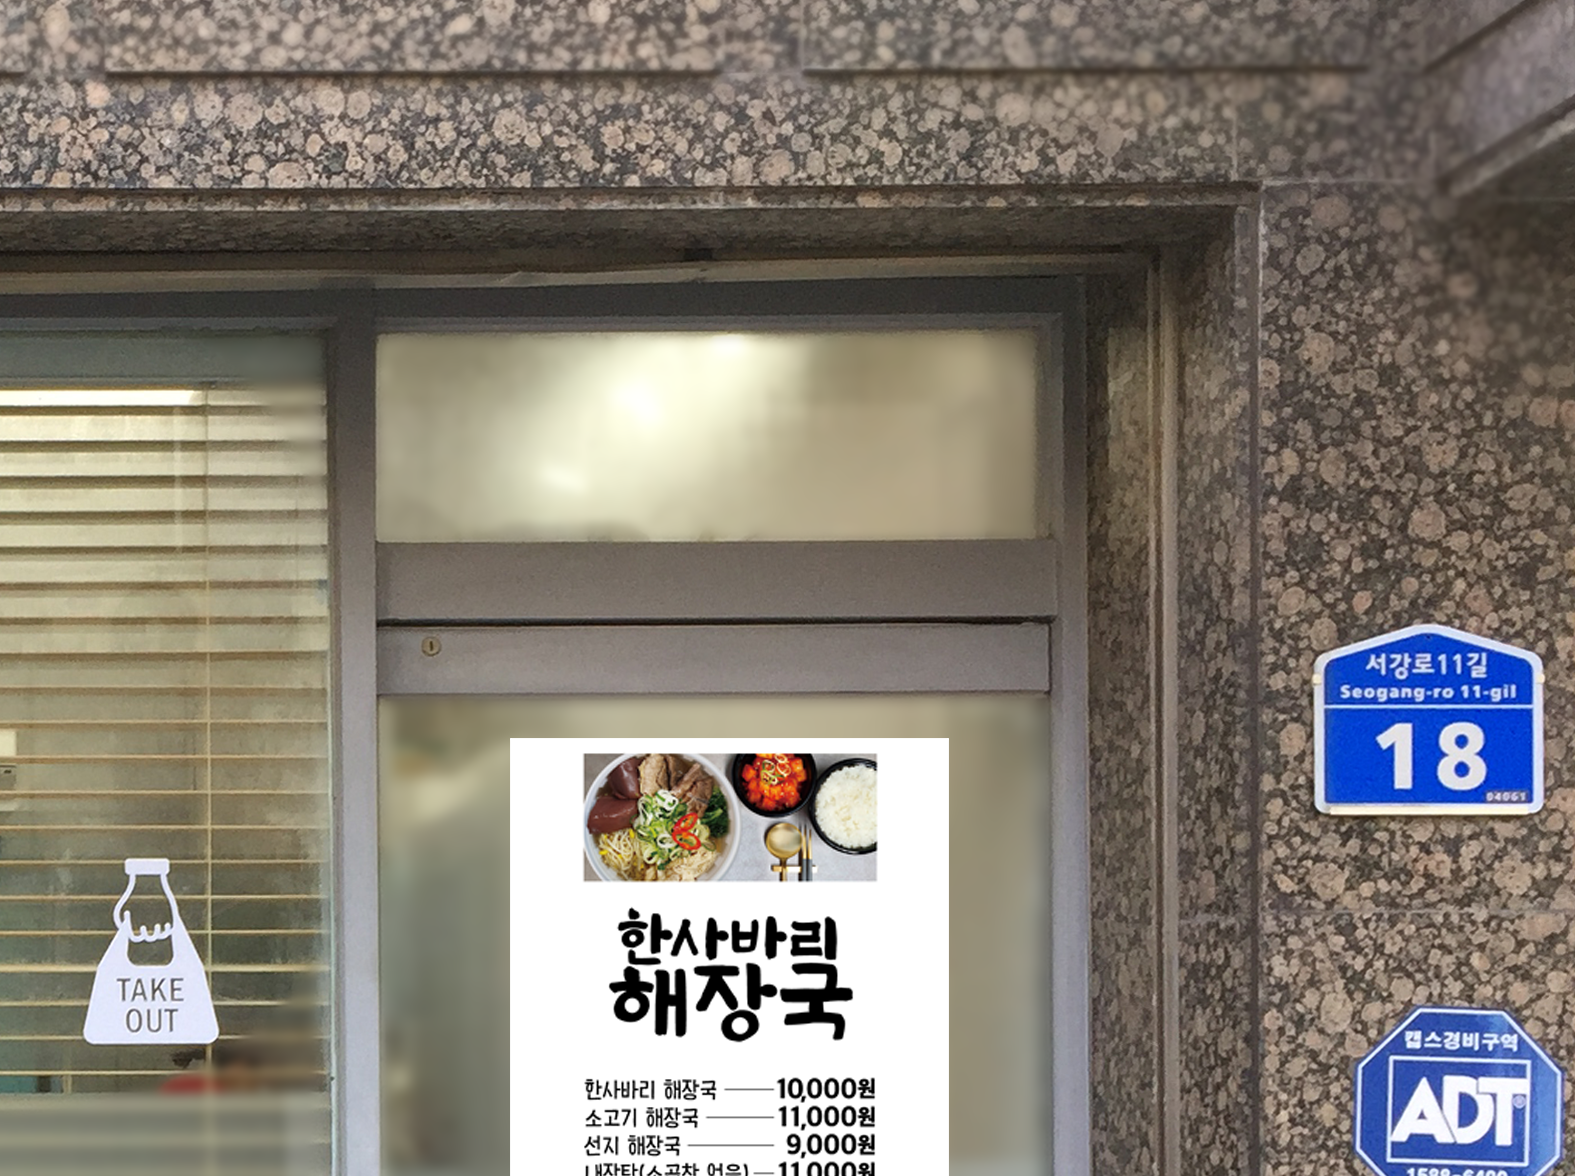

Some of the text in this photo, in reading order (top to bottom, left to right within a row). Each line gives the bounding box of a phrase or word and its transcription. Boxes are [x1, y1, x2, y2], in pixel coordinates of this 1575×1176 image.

[1365, 653, 1487, 679] 서강로11길
[1341, 684, 1519, 701] Seogang-ro 11-gil
[1376, 722, 1487, 790] 18
[617, 907, 838, 965] 한사바리
[117, 978, 183, 1001] TAKE
[608, 962, 854, 1042] 해장국
[126, 1009, 178, 1032] OUT
[1405, 1031, 1518, 1052] 캡스경비구역
[585, 1078, 875, 1103] 한사바리 해장국 10,000원
[586, 1105, 875, 1131] 소고기 해장국 11,000원
[1391, 1075, 1528, 1146] ADT
[584, 1134, 875, 1159] 선지 해장국 9,000원
